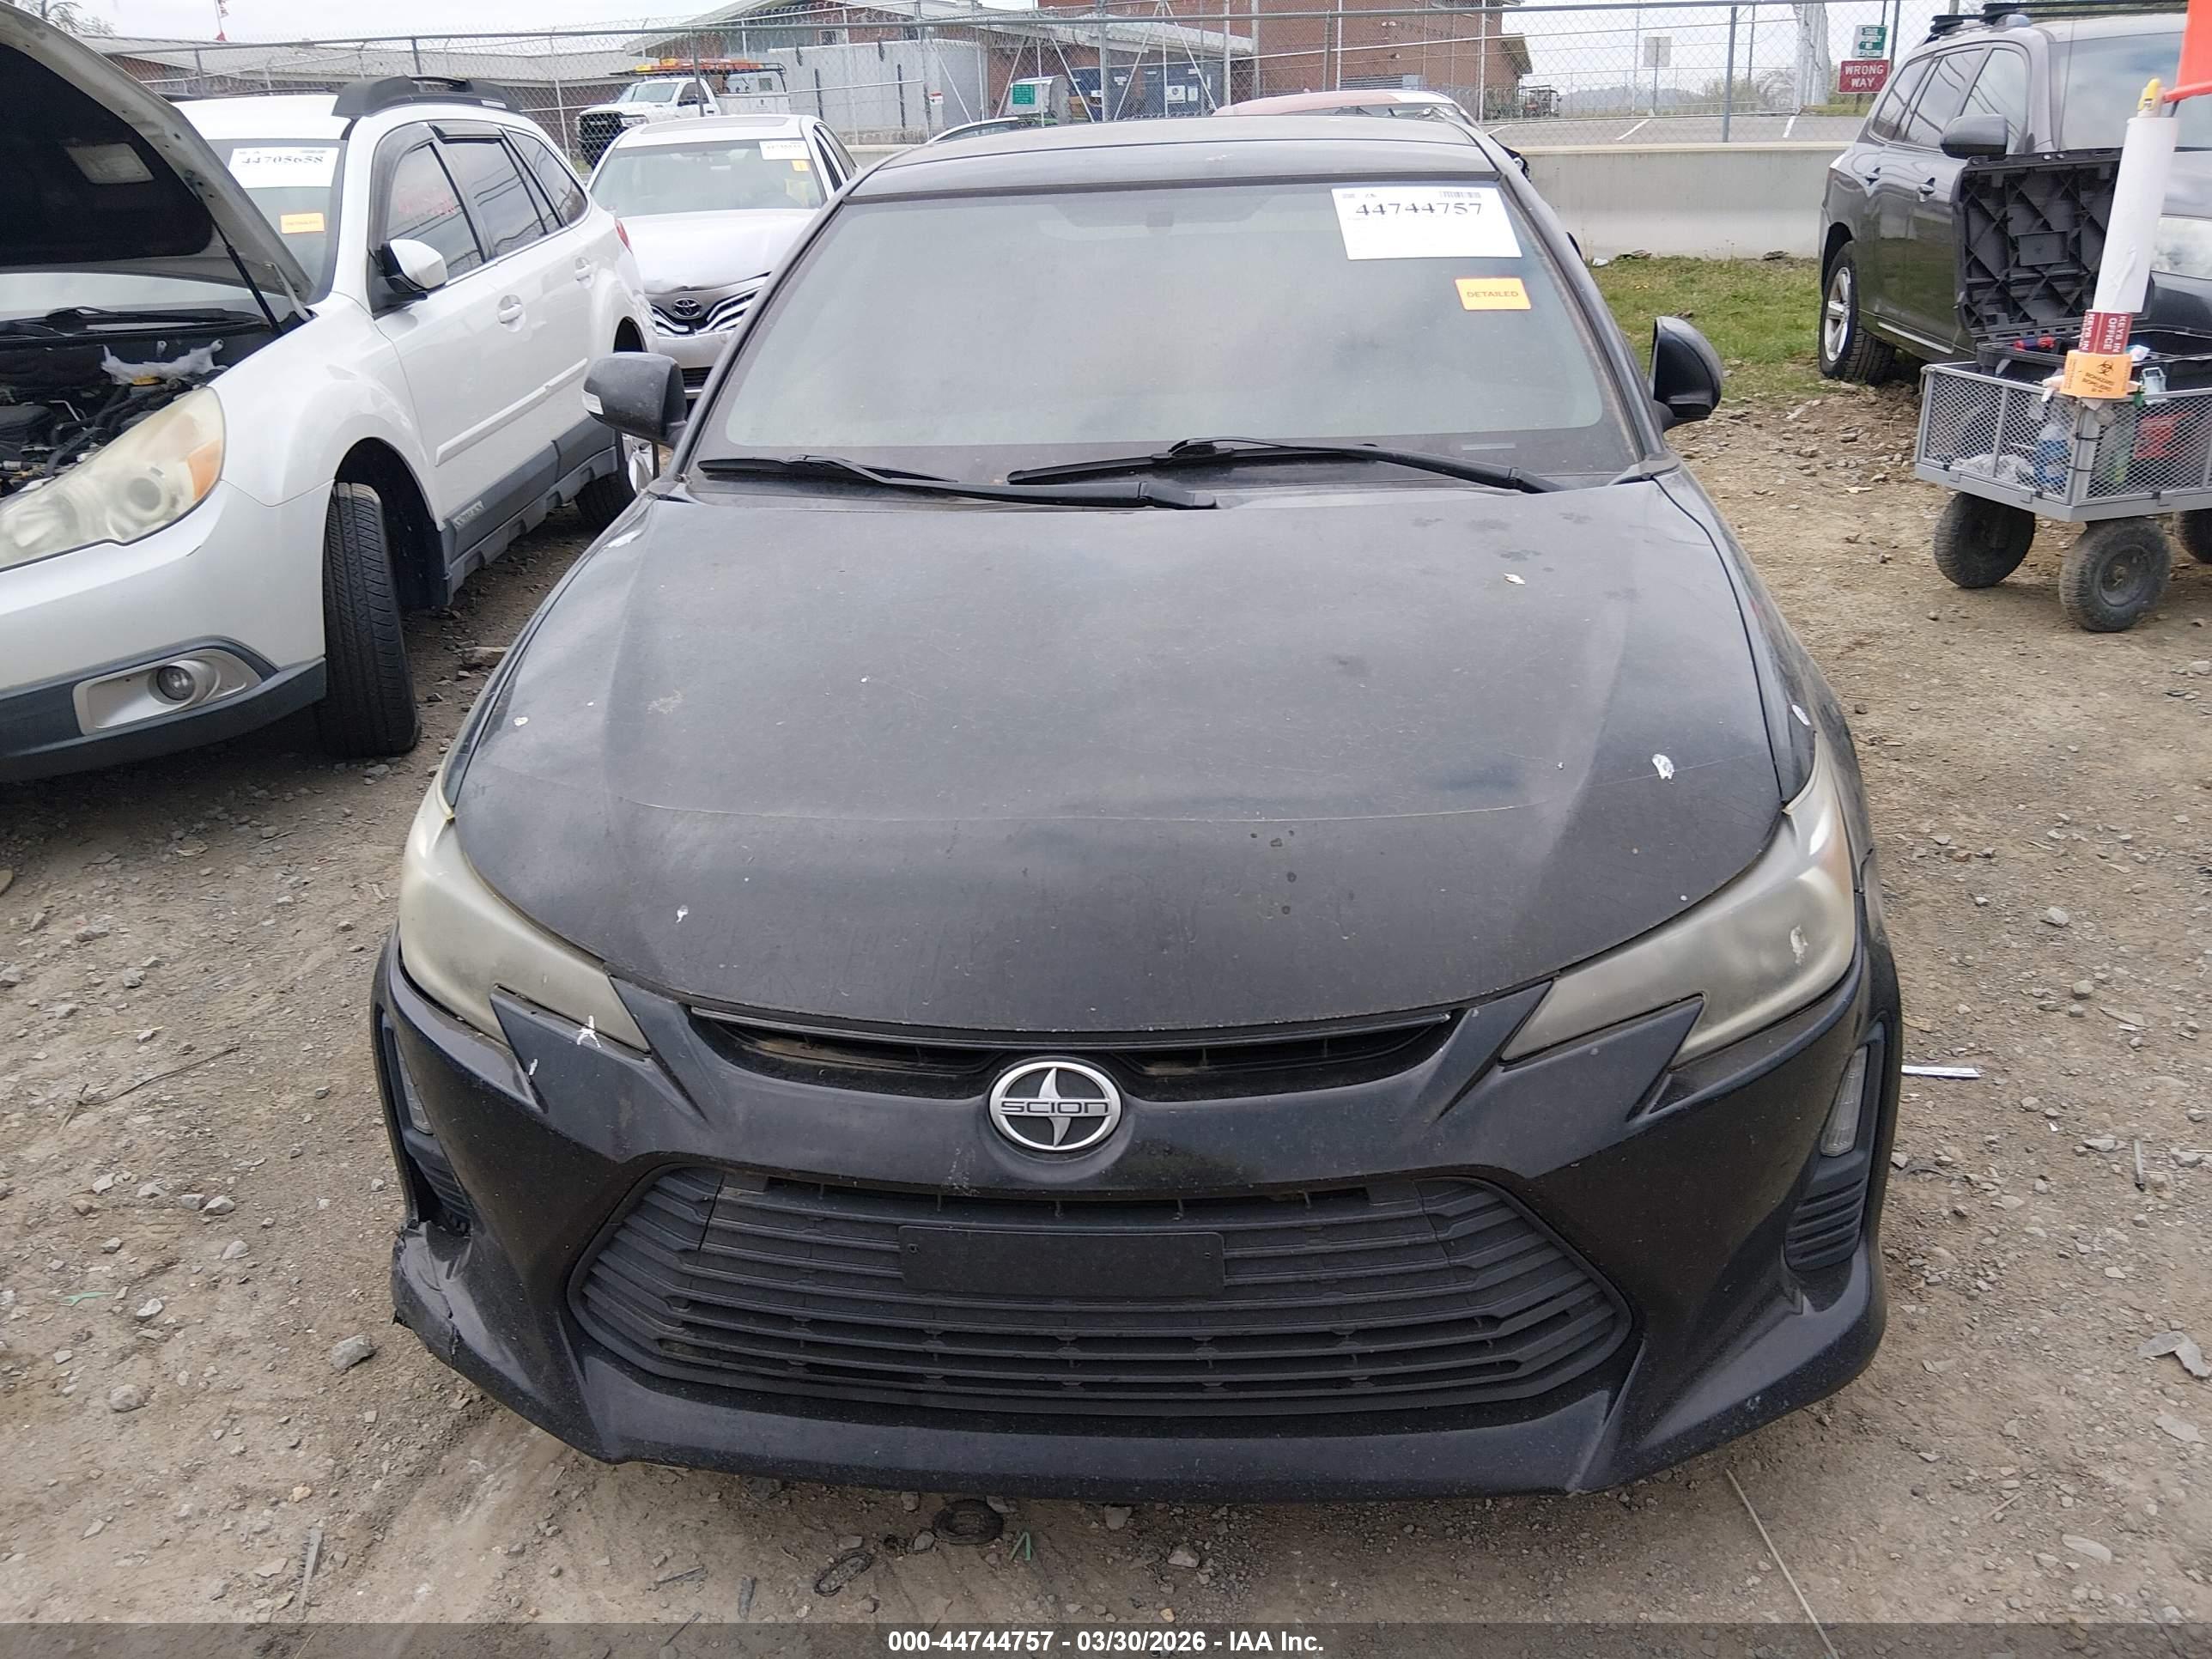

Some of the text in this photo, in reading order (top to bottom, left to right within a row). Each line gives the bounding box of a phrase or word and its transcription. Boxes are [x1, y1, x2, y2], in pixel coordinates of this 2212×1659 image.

[1845, 65, 1884, 75] WRONG
[1850, 77, 1875, 88] WAY
[1355, 203, 1483, 216] 44744757
[2103, 317, 2118, 350] OFFICE
[2112, 315, 2128, 353] KEYS IN
[1000, 1100, 1109, 1115] SCION
